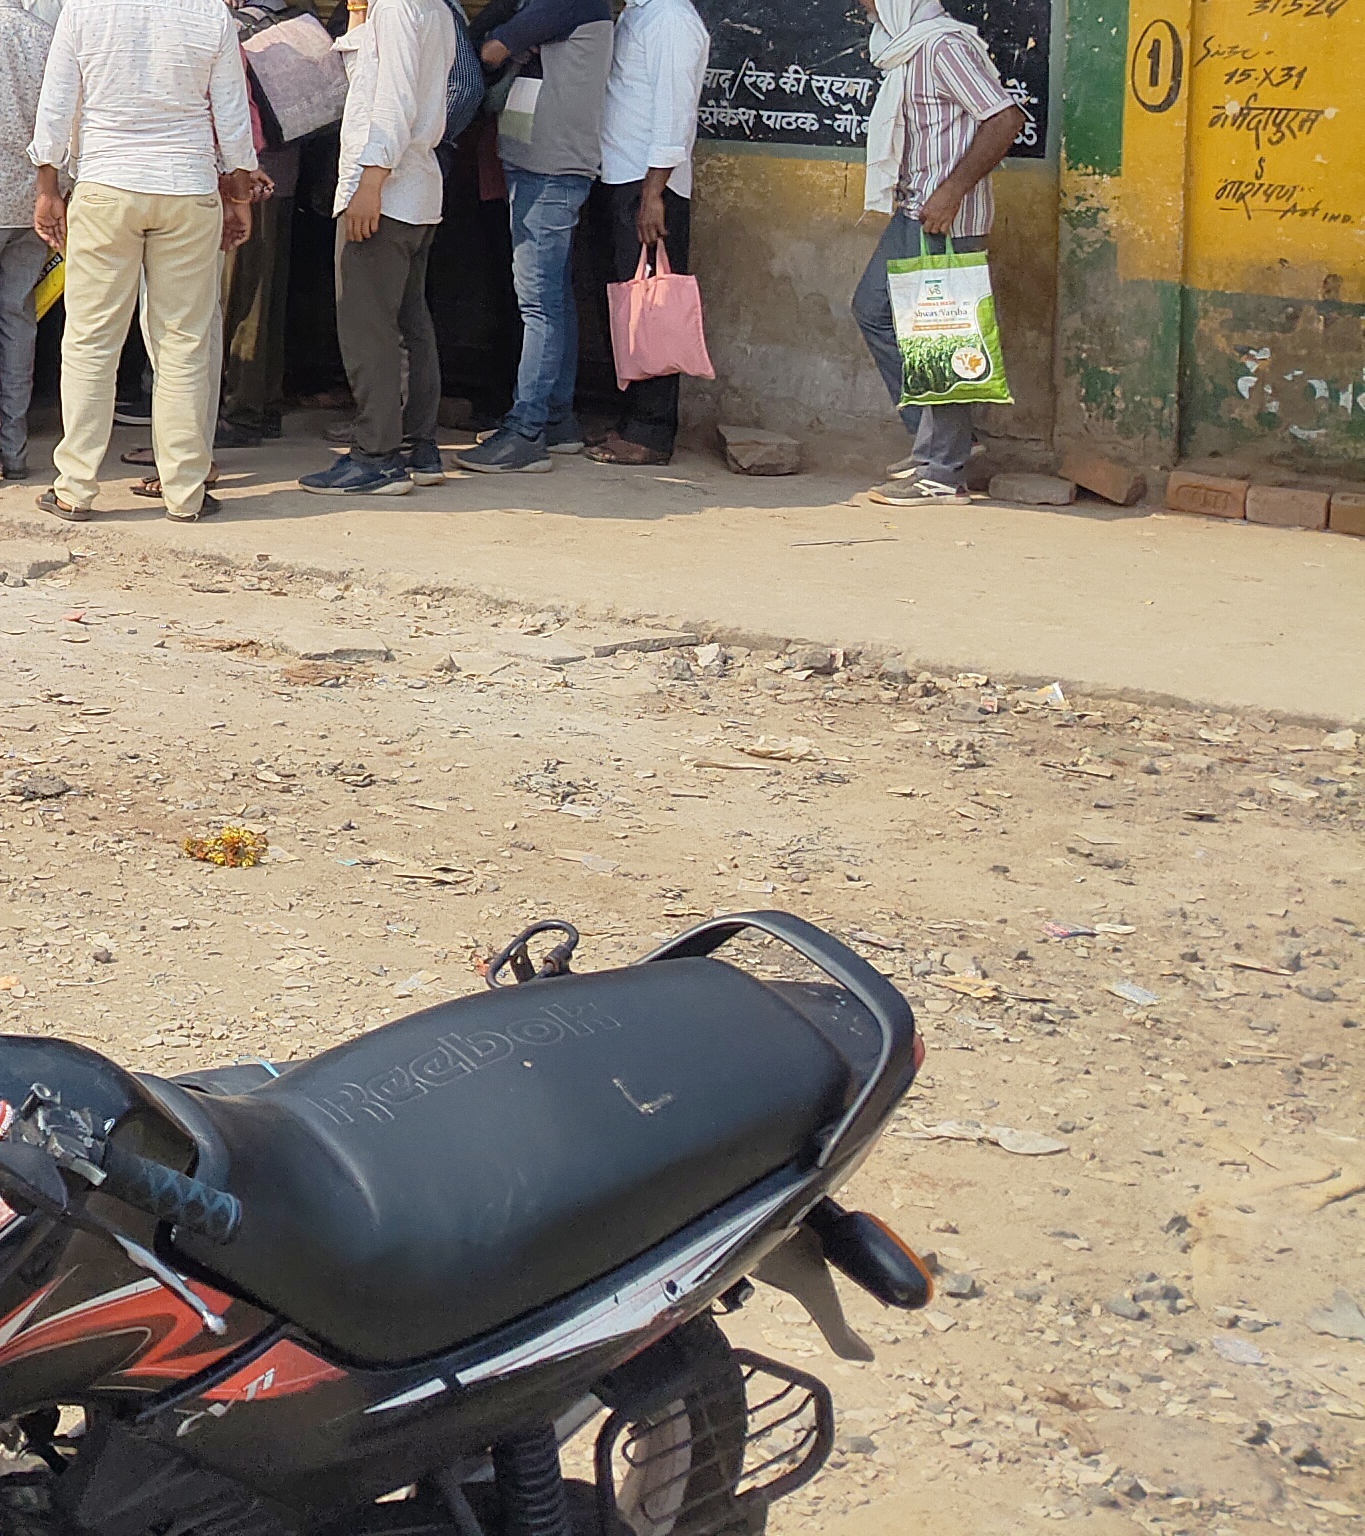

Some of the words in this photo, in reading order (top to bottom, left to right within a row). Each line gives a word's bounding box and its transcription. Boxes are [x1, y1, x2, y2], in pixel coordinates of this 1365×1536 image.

[779, 63, 810, 96] की
[811, 74, 873, 108] सूचना
[1146, 38, 1162, 87] 1
[759, 109, 821, 133] पाठक
[306, 1002, 622, 1126] Reebok
